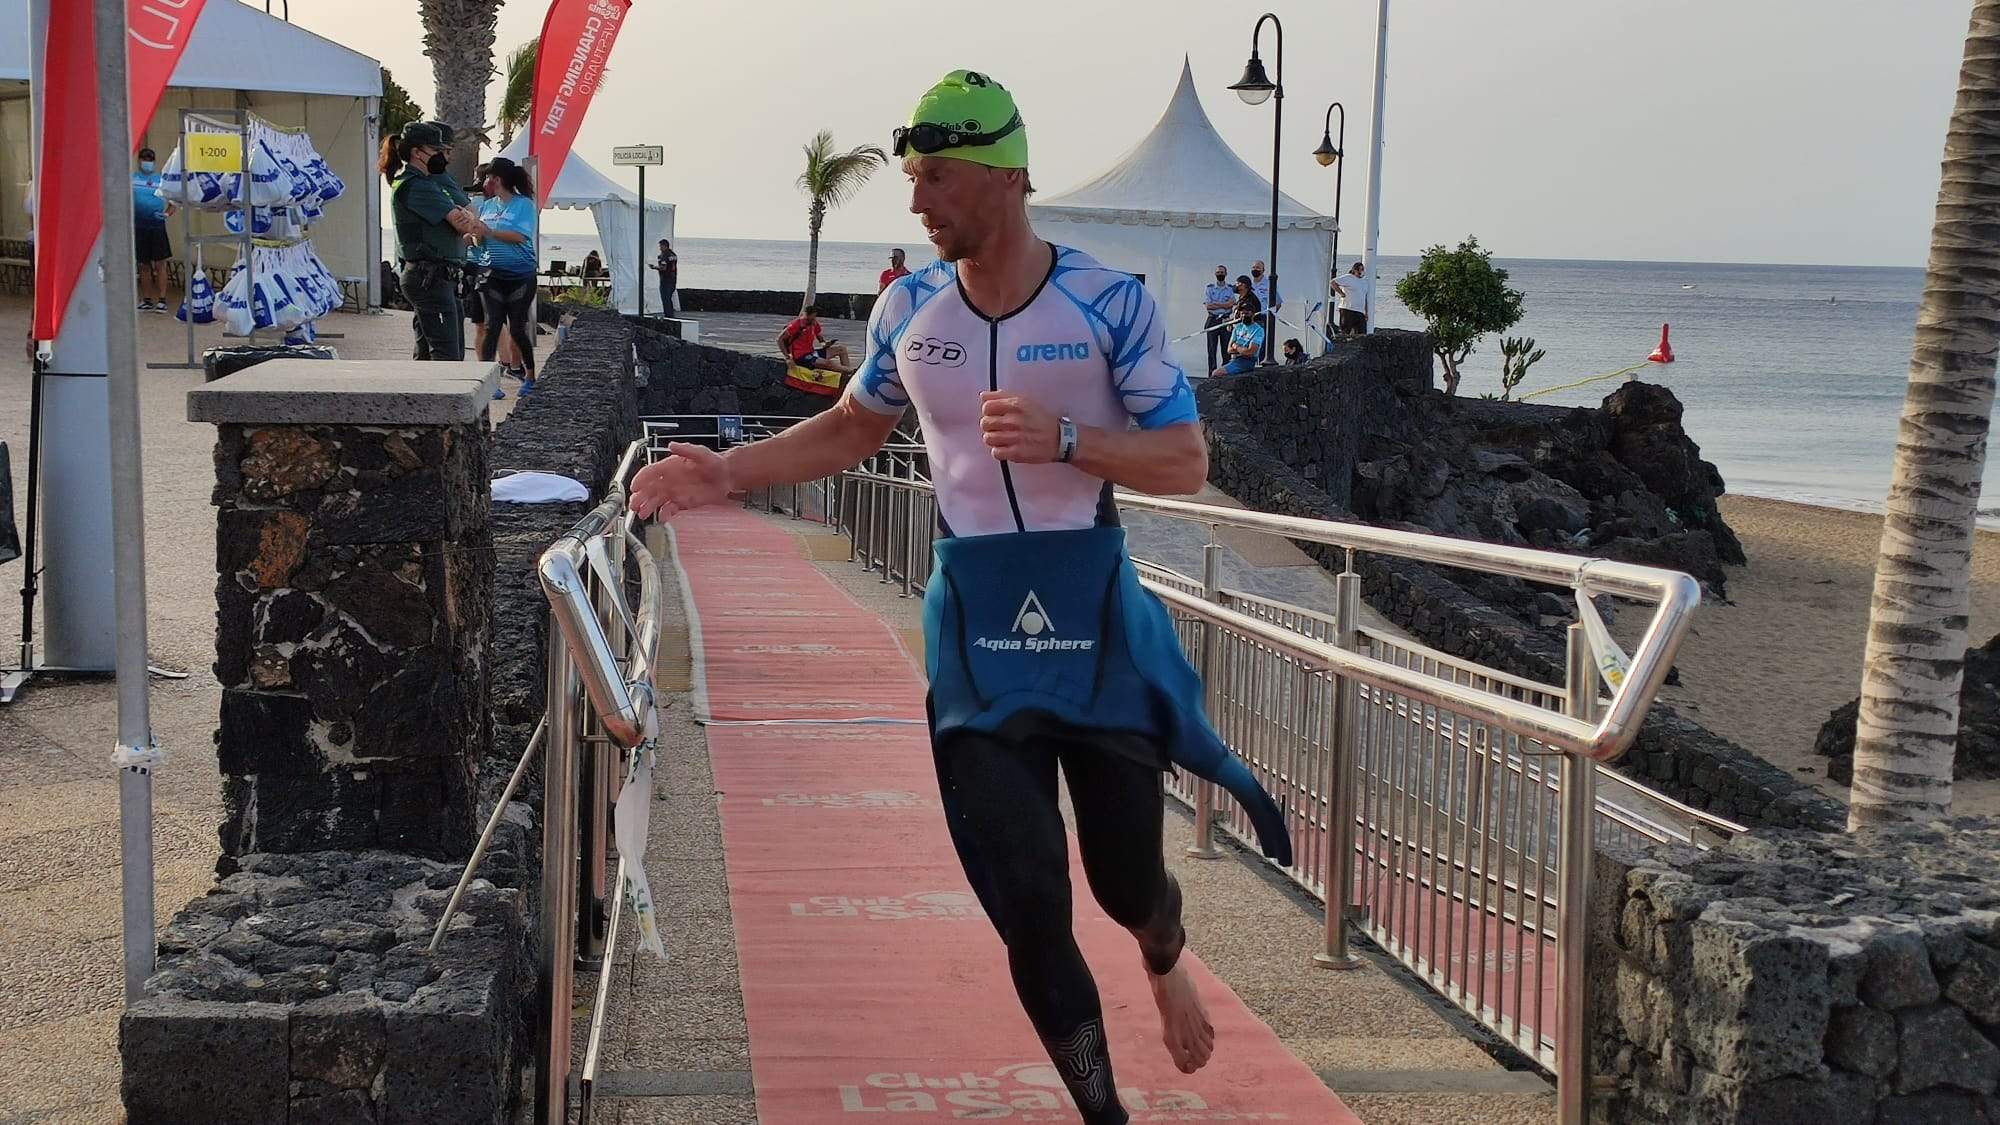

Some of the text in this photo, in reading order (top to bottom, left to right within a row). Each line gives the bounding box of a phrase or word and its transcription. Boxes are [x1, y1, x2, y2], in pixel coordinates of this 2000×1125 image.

[199, 147, 227, 158] 1-200
[907, 340, 962, 362] PTO
[1016, 342, 1090, 362] arena
[973, 637, 1096, 653] Aqua Sphere
[808, 896, 906, 906] Club
[864, 1072, 1000, 1089] Club
[838, 1085, 938, 1112] La
